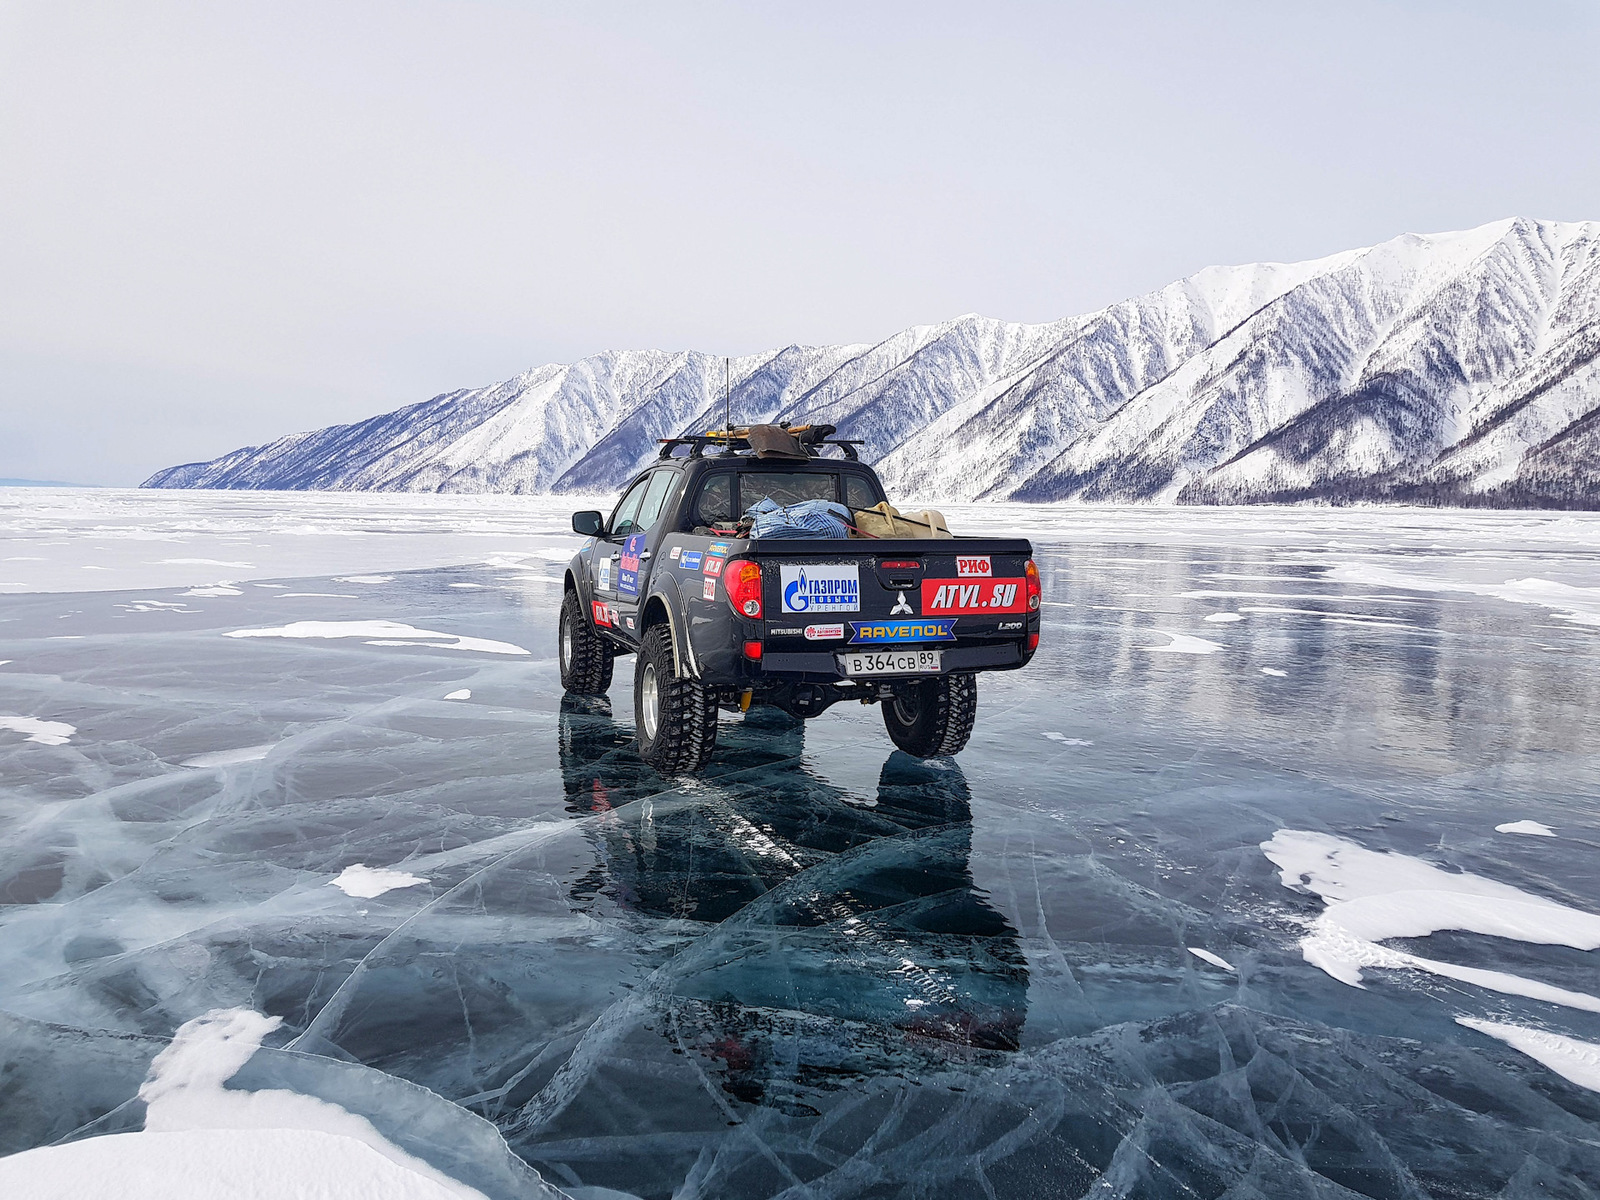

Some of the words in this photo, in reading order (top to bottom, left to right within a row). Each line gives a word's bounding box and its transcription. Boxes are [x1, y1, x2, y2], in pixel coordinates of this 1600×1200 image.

[958, 560, 990, 573] РИФ
[809, 580, 858, 594] ГАЗПРОМ
[810, 595, 857, 604] ДОБЫЧА
[931, 584, 1018, 608] ATVL.SU
[770, 628, 803, 636] MITSUBISHI
[860, 625, 948, 638] RAVENOL
[998, 622, 1022, 630] L200
[920, 653, 934, 665] 89
